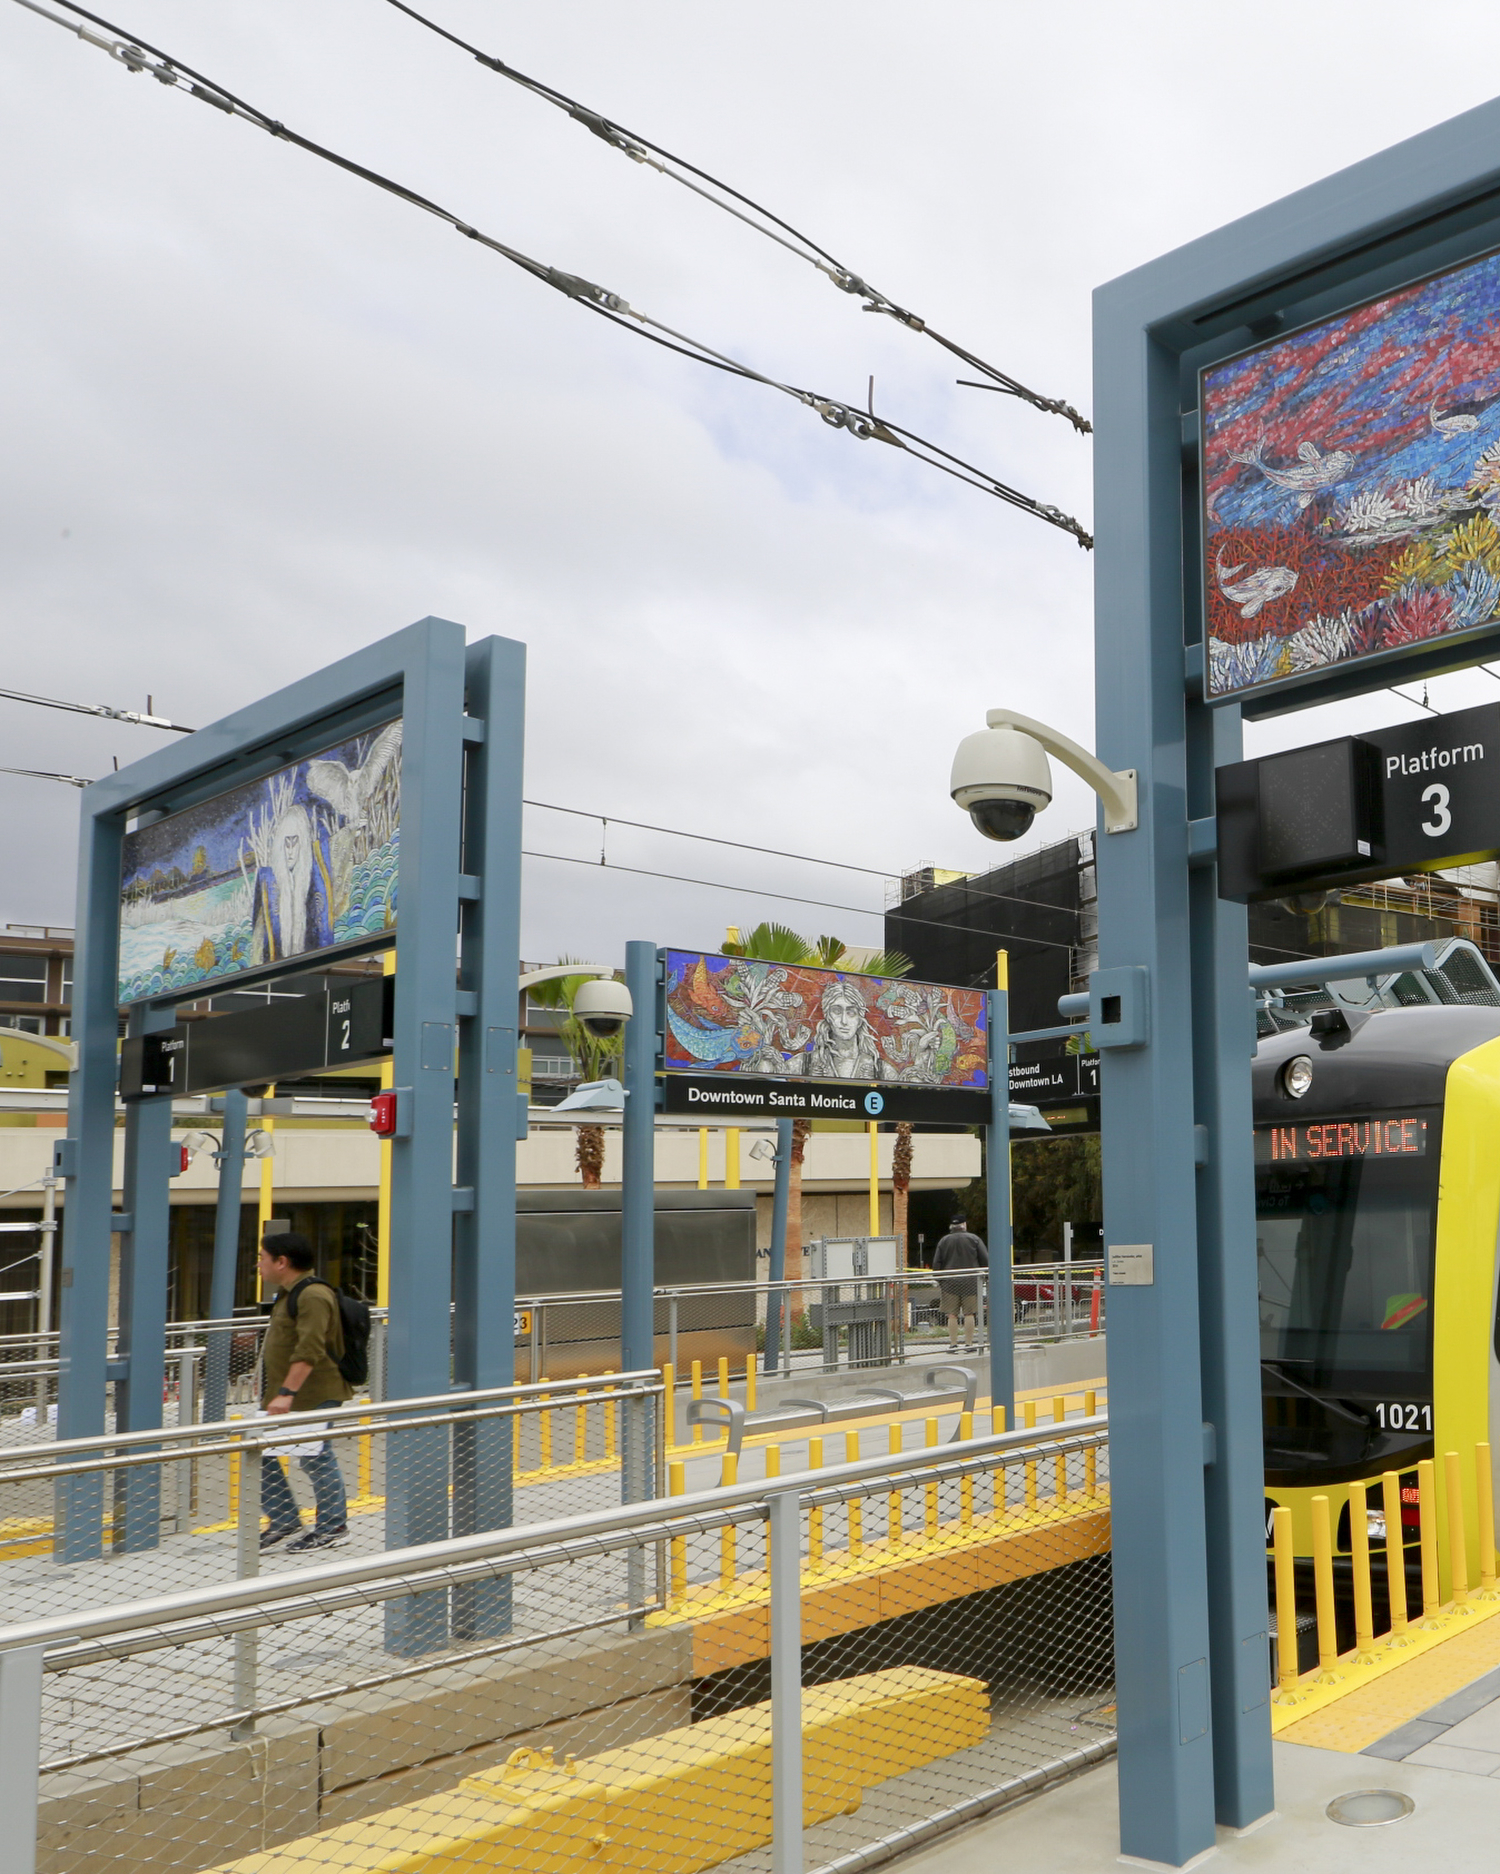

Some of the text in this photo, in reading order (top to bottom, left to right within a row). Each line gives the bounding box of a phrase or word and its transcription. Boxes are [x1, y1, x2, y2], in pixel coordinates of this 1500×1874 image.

[1386, 743, 1484, 779] Platform
[1421, 783, 1452, 837] 3
[332, 999, 350, 1015] Platf
[161, 1039, 184, 1052] Platform
[341, 1020, 350, 1050] 2
[168, 1057, 175, 1083] 1
[1009, 1064, 1040, 1077] stbound
[1081, 1058, 1100, 1067] Platfor
[1009, 1074, 1063, 1090] Downtown LA
[1090, 1069, 1097, 1086] 1
[688, 1087, 878, 1110] Downtown Santa Monica E
[1271, 1118, 1419, 1160] IN SERVICE
[1375, 1403, 1432, 1430] 1021
